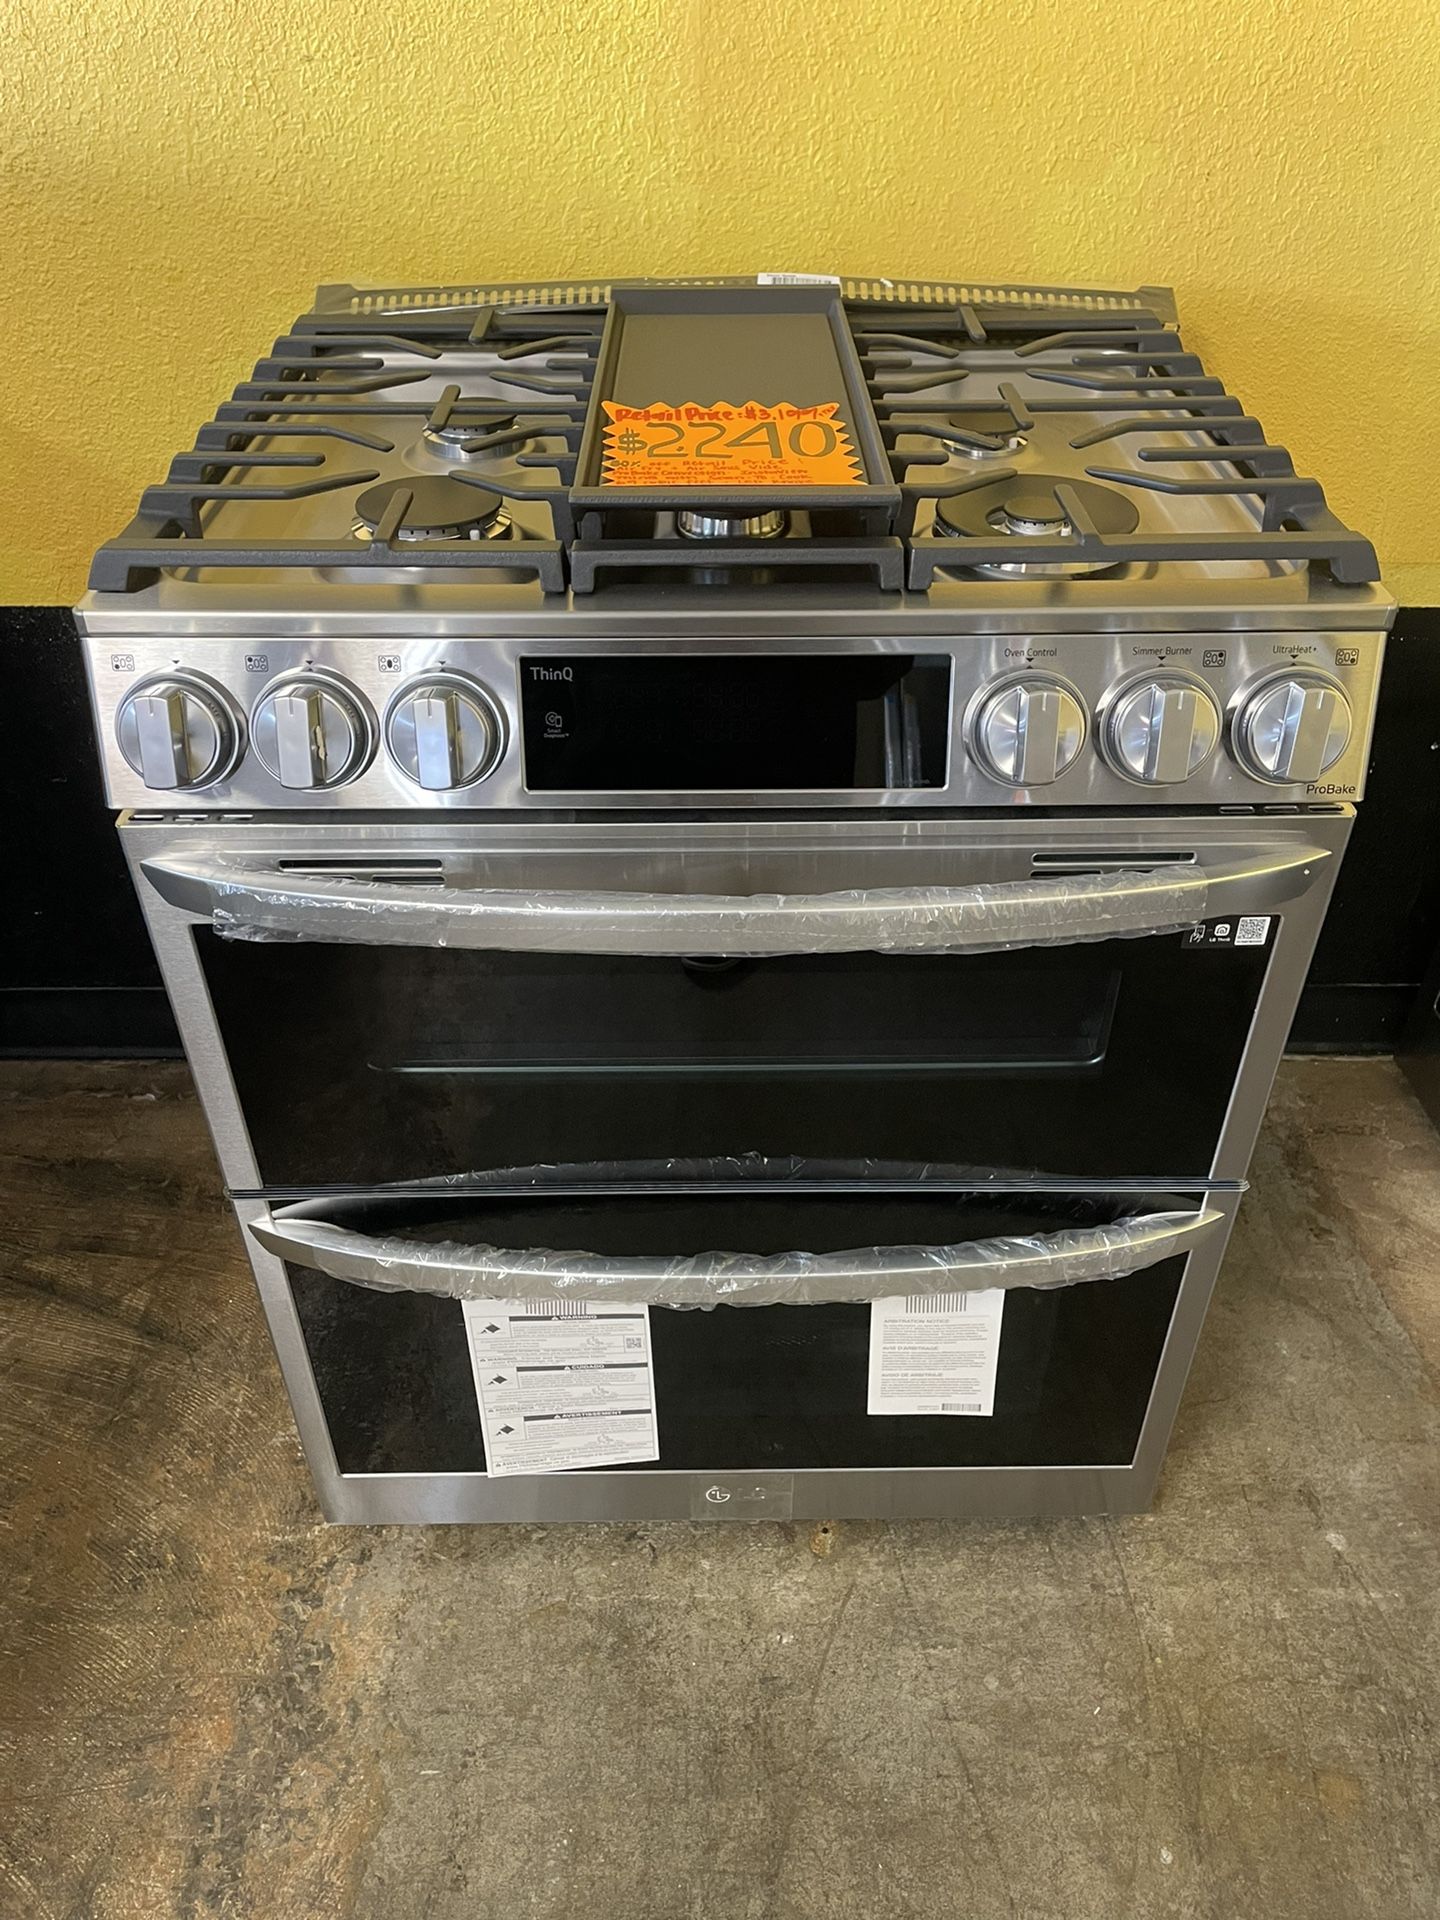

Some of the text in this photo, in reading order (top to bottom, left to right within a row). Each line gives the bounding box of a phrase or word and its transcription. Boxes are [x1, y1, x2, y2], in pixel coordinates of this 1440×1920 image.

[615, 408, 682, 422] Retail
[1004, 648, 1058, 657] Oven Control
[1132, 646, 1193, 656] Simmer Burner
[529, 666, 574, 682] ThinQ
[1306, 783, 1356, 795] ProBake
